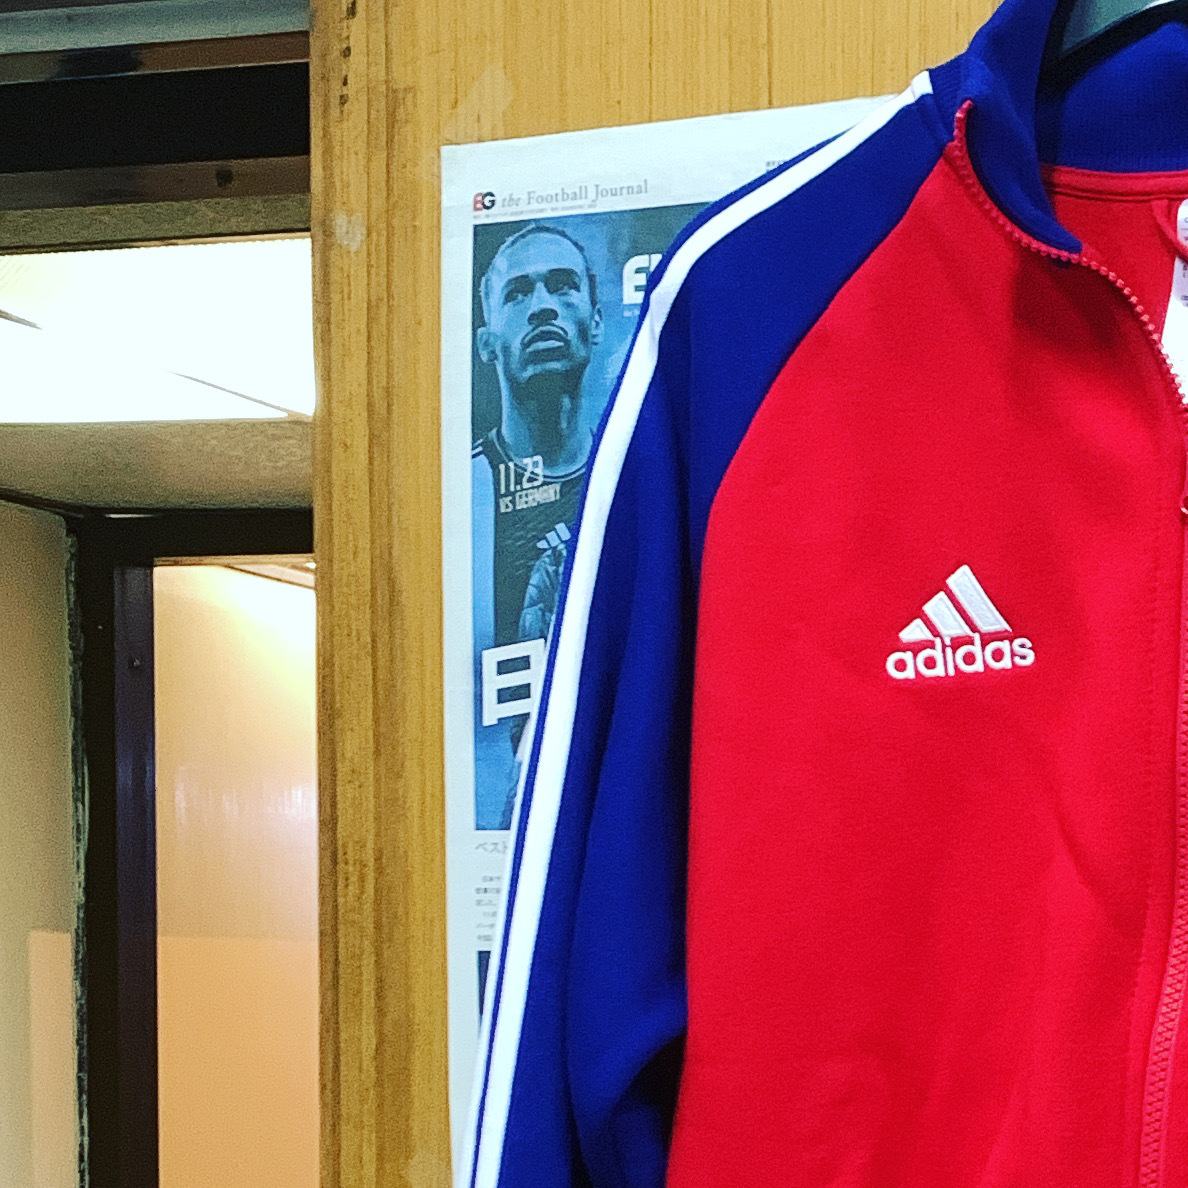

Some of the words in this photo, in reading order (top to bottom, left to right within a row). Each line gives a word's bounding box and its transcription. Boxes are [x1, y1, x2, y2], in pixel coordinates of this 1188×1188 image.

[501, 194, 521, 209] the
[526, 185, 588, 205] Football
[593, 178, 649, 198] Journal
[499, 455, 543, 494] 11.23
[499, 496, 513, 513] VS
[515, 483, 561, 510] GERMANY
[885, 632, 1035, 679] adidas
